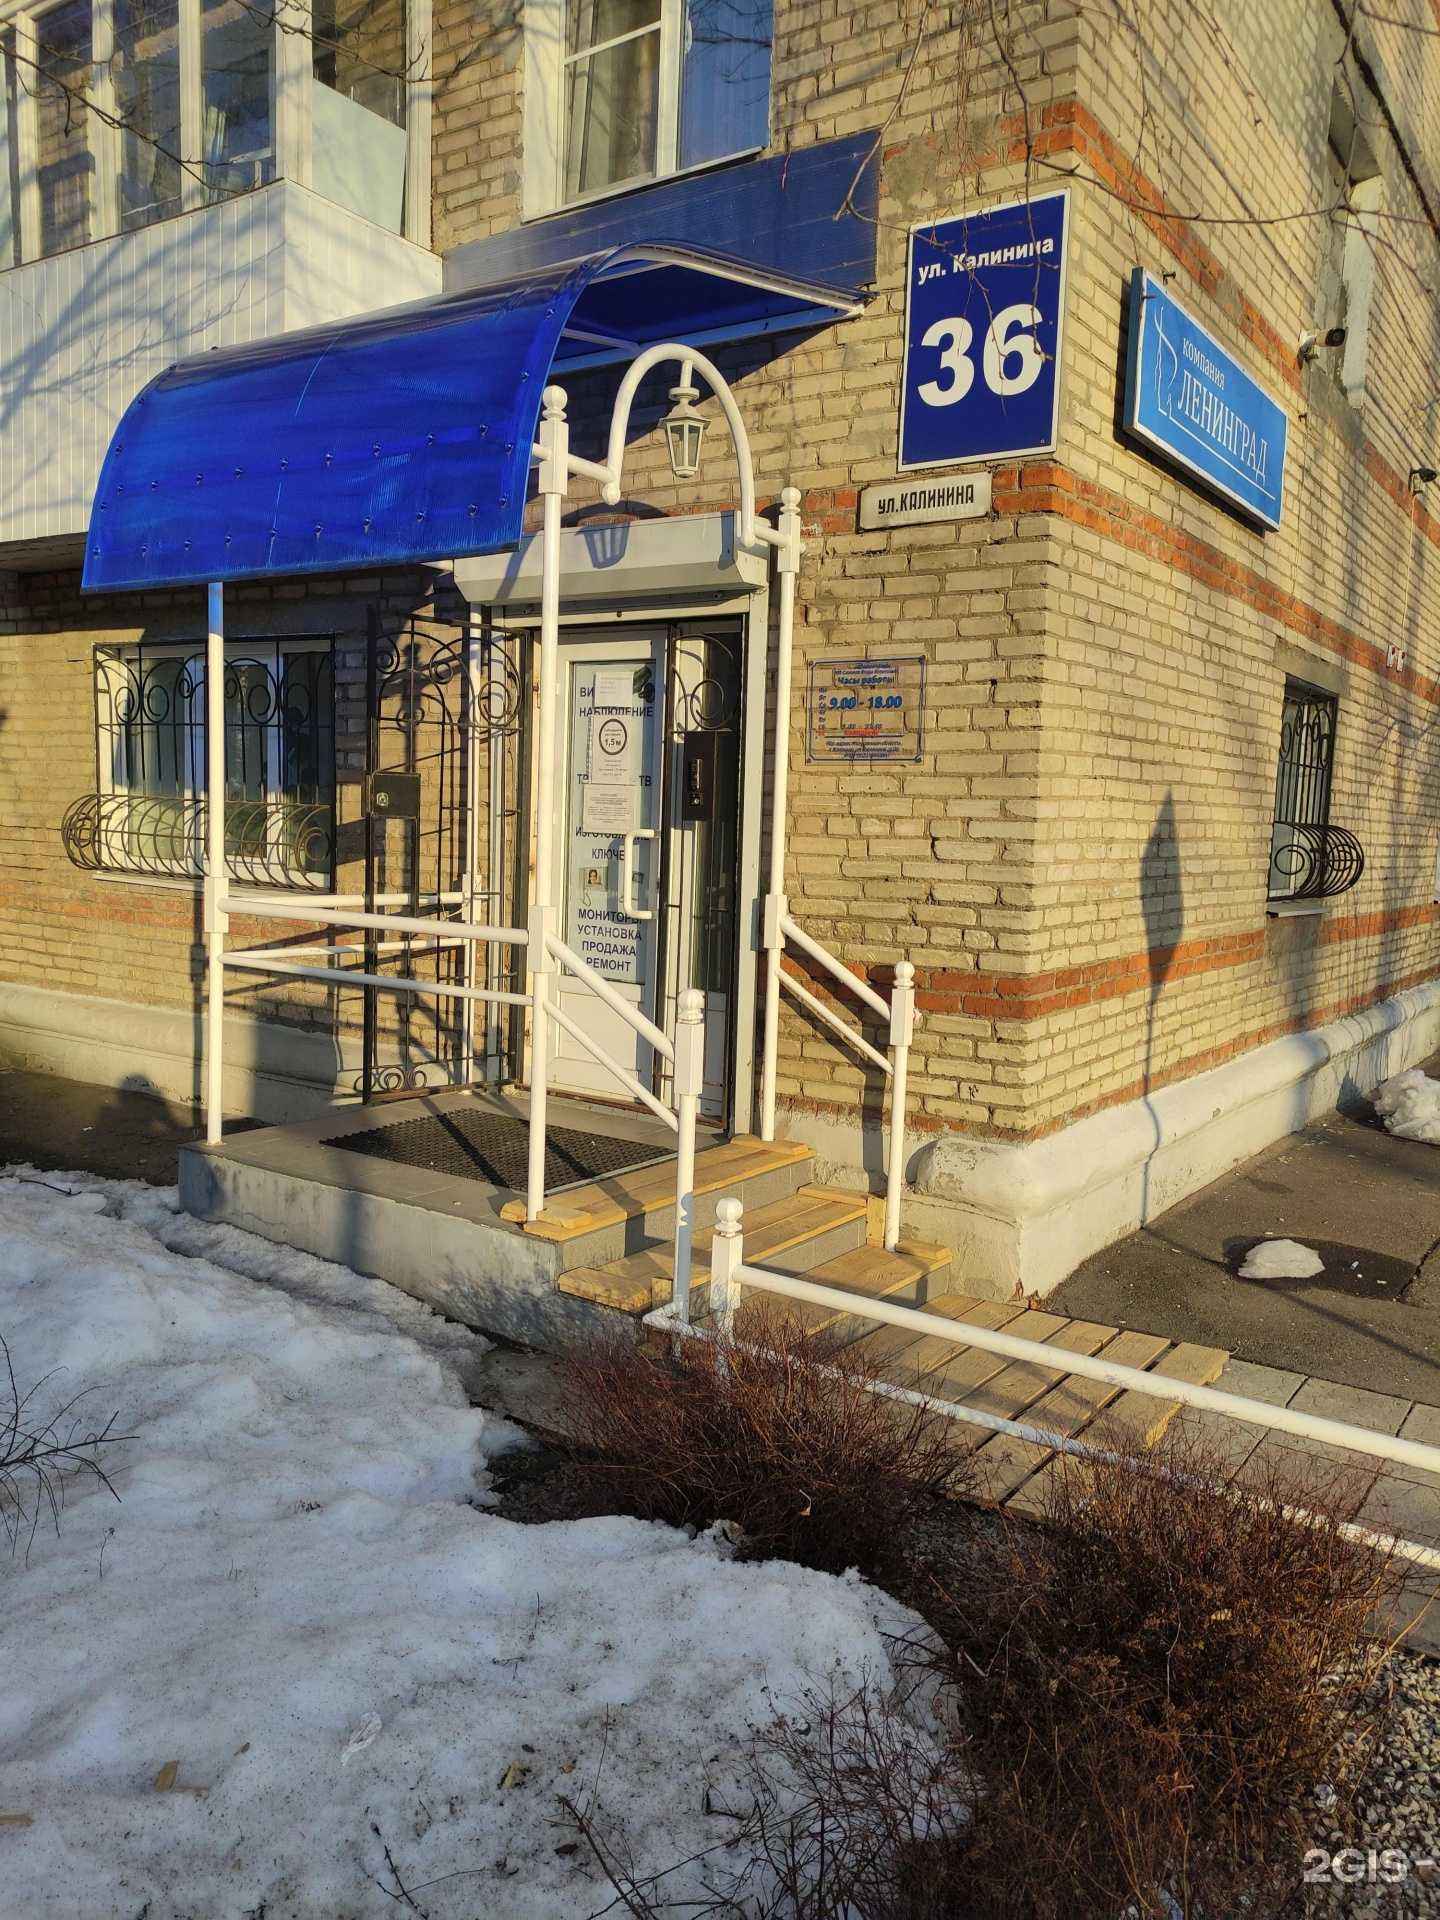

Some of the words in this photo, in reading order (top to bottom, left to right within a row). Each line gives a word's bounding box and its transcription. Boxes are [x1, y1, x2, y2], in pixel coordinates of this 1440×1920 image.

[917, 263, 947, 287] ул.
[952, 236, 1054, 274] Калинина
[917, 303, 1046, 408] 36
[1177, 368, 1269, 485] ЛЕНИНГРАД
[829, 696, 856, 710] 9.00
[868, 695, 903, 710] 18.00
[591, 848, 625, 861] КЛЮЧЕ
[577, 924, 642, 941] УСТАНОВКА
[581, 940, 637, 957] ПРОДАЖА
[586, 956, 632, 973] РЕМОНТ
